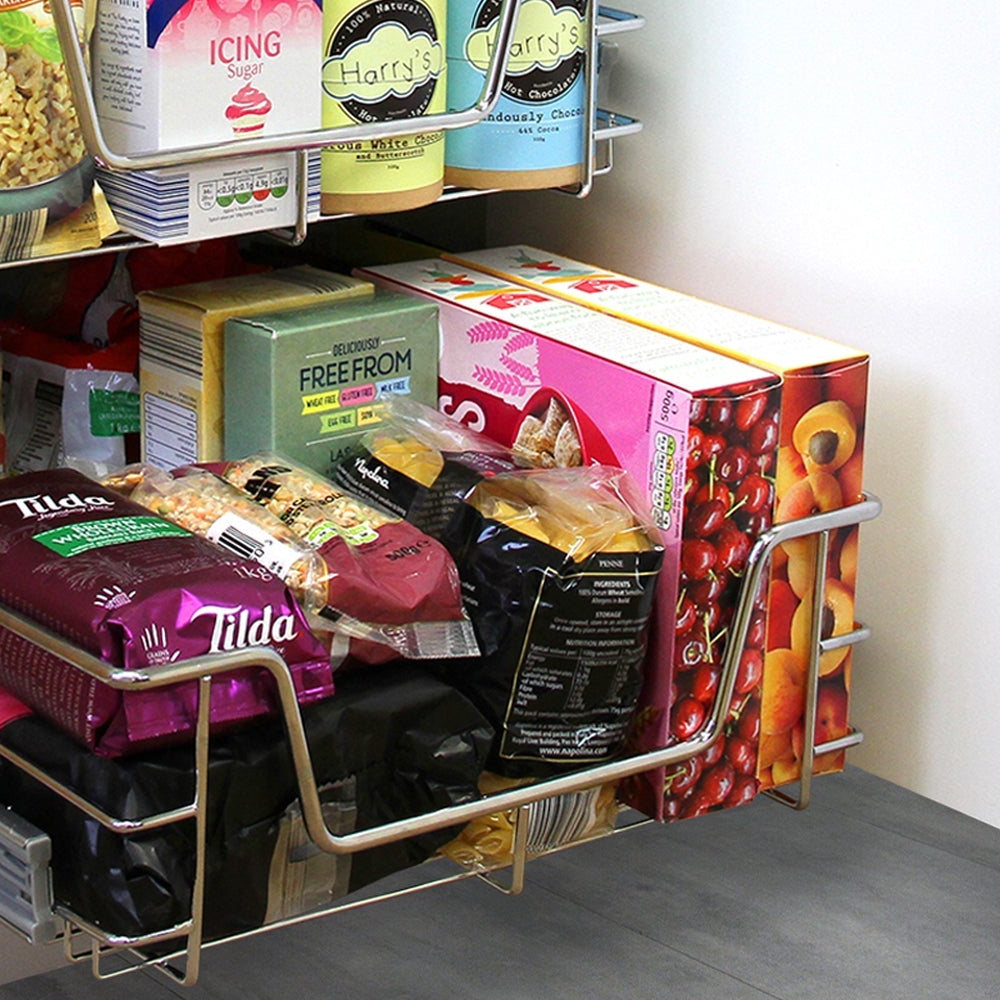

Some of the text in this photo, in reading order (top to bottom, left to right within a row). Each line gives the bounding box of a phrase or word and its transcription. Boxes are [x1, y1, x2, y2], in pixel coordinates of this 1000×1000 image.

[345, 2, 421, 33] 100% Natural
[209, 30, 281, 66] ICING
[227, 62, 265, 81] Sugar
[340, 50, 431, 86] Harry's
[504, 70, 578, 99] Hot Chocolate
[370, 138, 409, 149] White
[660, 389, 675, 422] 500g
[599, 560, 624, 569] PENNE
[190, 604, 299, 655] Tilda
